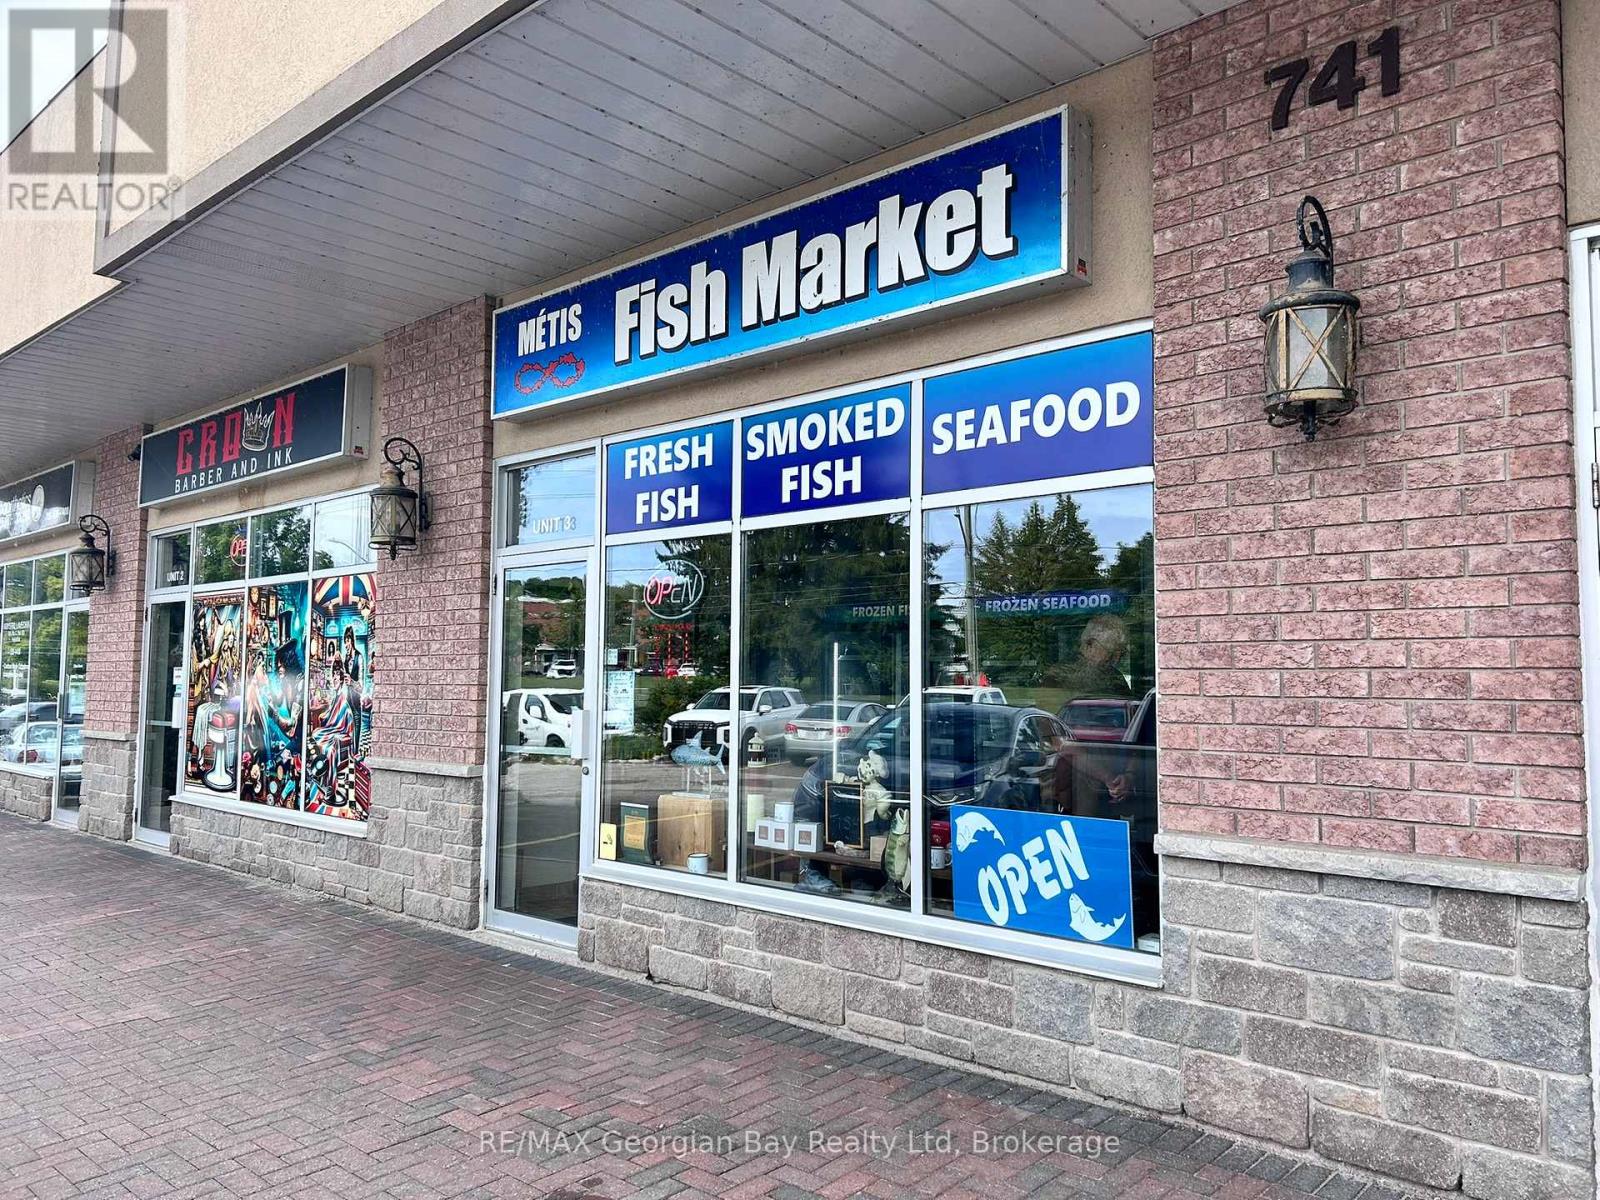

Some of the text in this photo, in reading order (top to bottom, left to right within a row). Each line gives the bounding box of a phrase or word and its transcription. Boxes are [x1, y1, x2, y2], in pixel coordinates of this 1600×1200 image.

[1264, 26, 1400, 131] 741
[614, 164, 1017, 366] Fish Market
[517, 303, 583, 357] MÉTIS
[746, 396, 905, 462] SMOKED
[932, 380, 1140, 455] SEAFOOD
[174, 446, 293, 494] BARBER AND INK
[623, 432, 714, 480] FRESH
[780, 455, 863, 503] FISH
[532, 516, 561, 534] UNIT
[634, 483, 700, 525] FISH
[166, 571, 180, 582] UNIT
[852, 604, 910, 618] FROZEN FI
[985, 594, 1112, 613] FROZEN SEAFOOD
[977, 820, 1090, 927] OPEN
